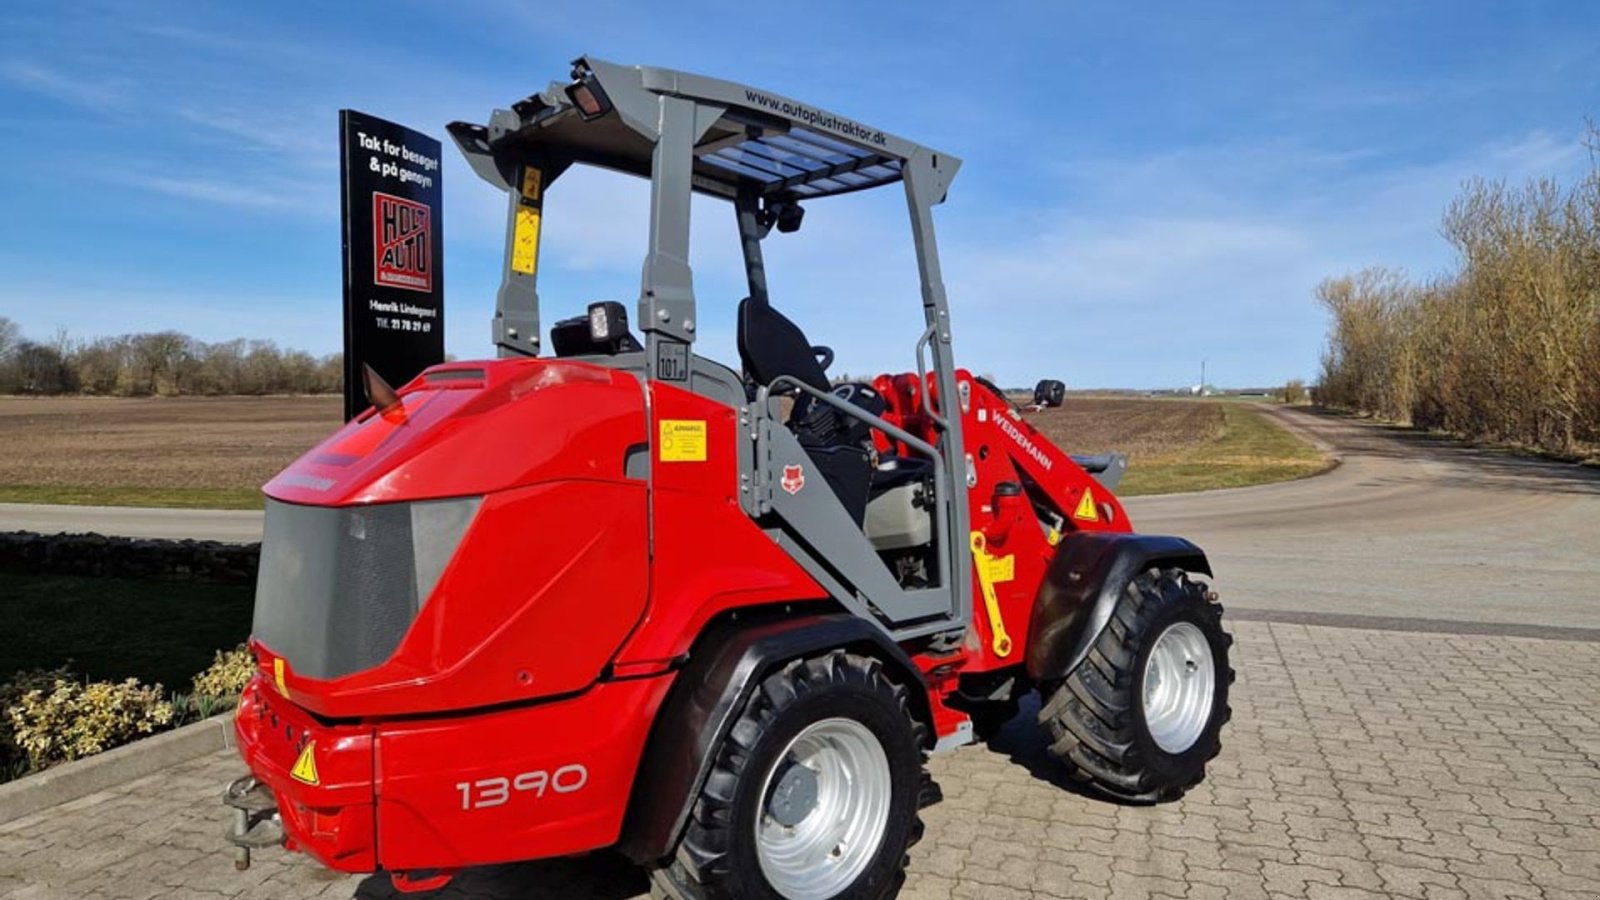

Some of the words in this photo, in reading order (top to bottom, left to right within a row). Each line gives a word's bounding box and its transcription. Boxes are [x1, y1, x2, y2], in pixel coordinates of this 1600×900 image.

[745, 90, 887, 146] www.autoplustraktor.dk
[357, 132, 381, 152] Tak
[383, 139, 401, 157] for
[369, 156, 381, 172] &
[382, 161, 399, 178] på
[400, 168, 432, 189] gensyn
[382, 200, 425, 245] HOLT
[381, 231, 426, 272] AUTO
[369, 299, 399, 313] Henrik
[660, 357, 677, 378] 101
[993, 409, 1052, 470] WEIDEMANN
[456, 764, 587, 810] 1390
